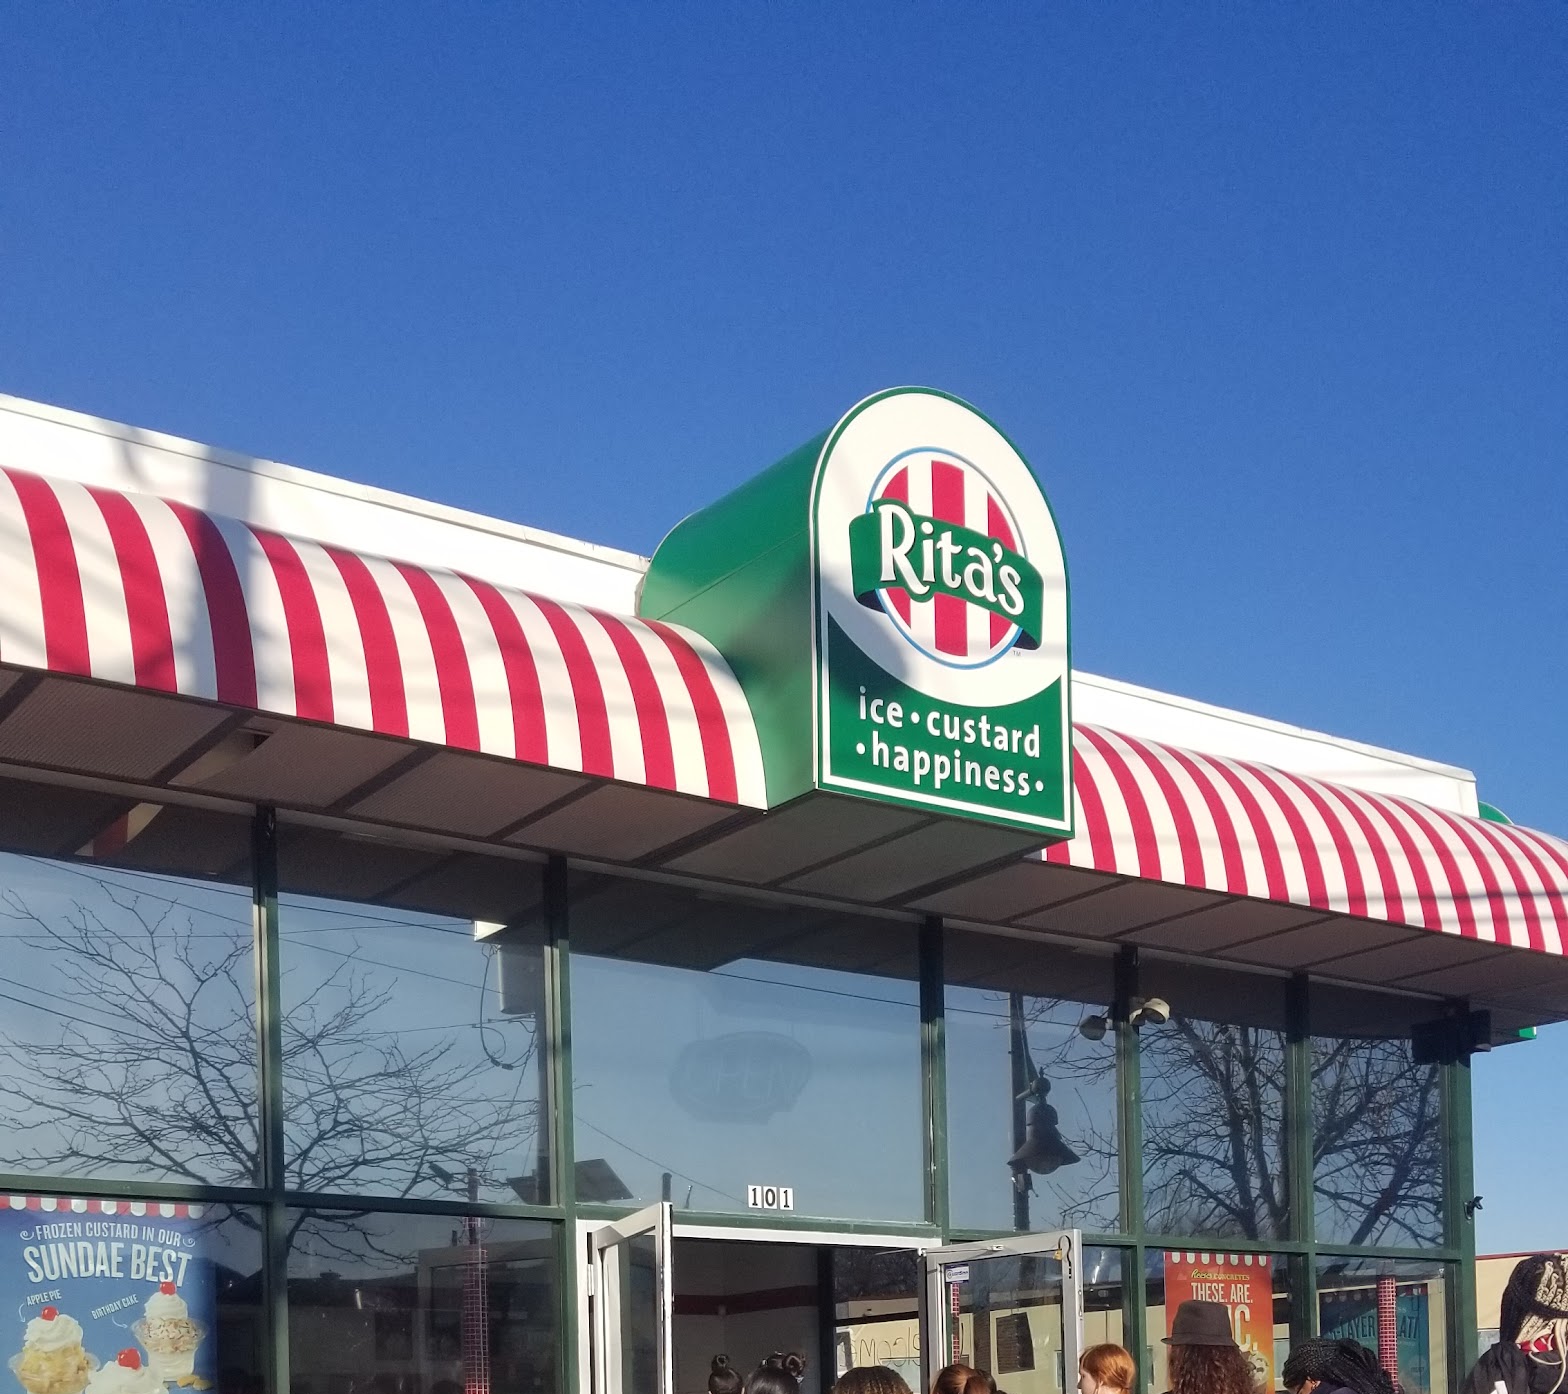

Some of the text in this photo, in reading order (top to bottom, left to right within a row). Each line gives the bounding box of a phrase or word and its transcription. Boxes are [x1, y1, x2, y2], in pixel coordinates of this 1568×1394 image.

[878, 503, 1025, 617] Rita's
[858, 686, 1041, 758] ice custard
[871, 731, 1031, 797] happiness
[751, 1187, 790, 1209] 101
[35, 1221, 182, 1247] FROZEN CUSTARD IN OUR
[23, 1241, 193, 1287] SUNDAE BEST
[26, 1289, 63, 1307] APPLE PIE
[1191, 1282, 1254, 1303] THESE. ARE.
[91, 1294, 139, 1320] BIRTHDAY CAKE
